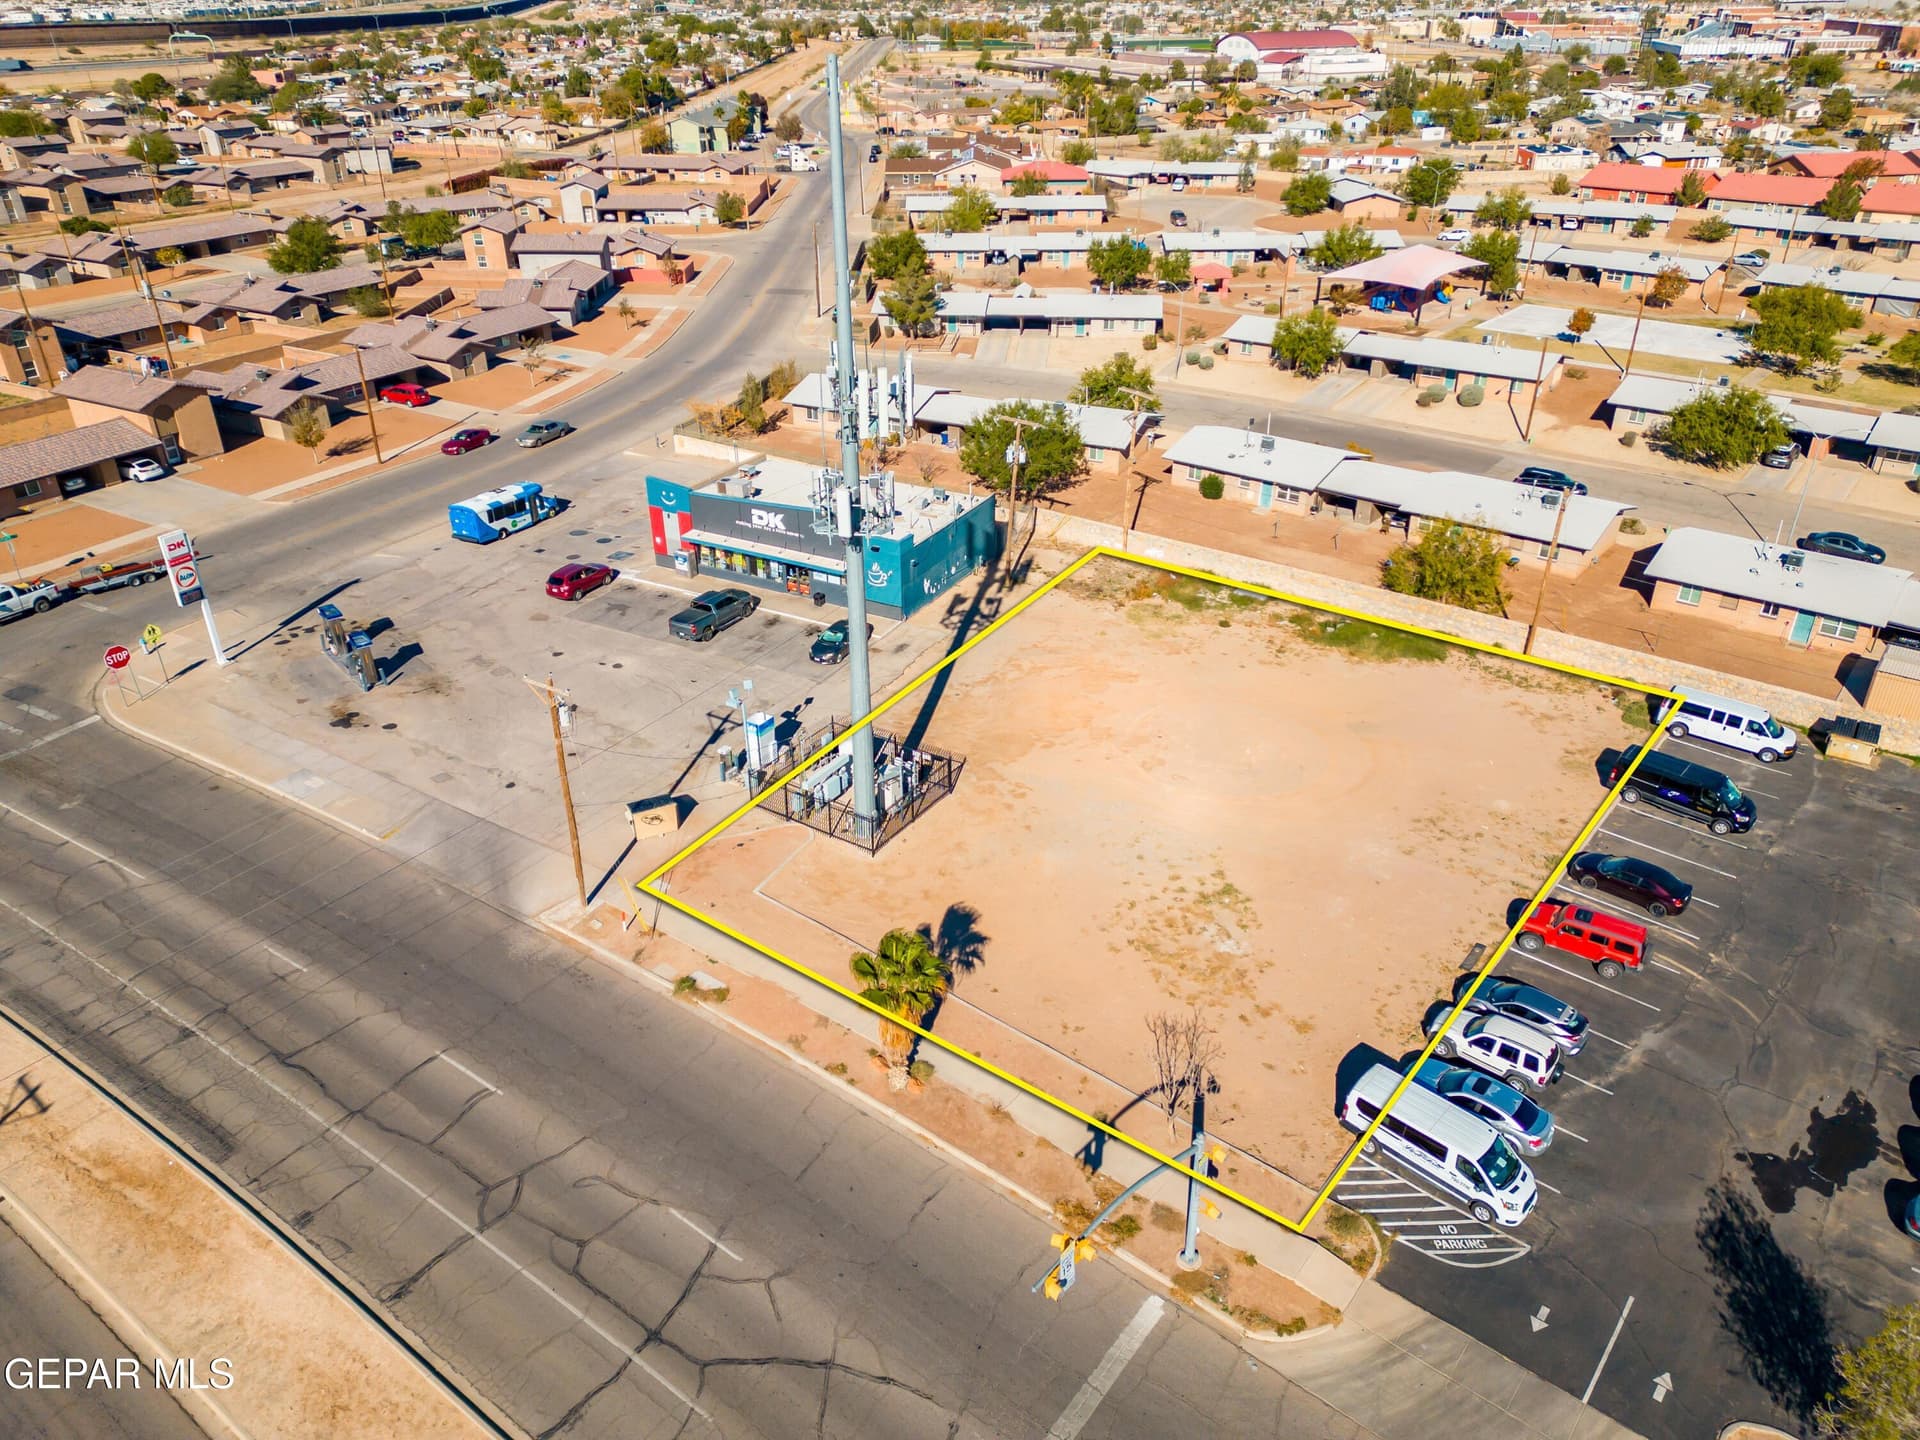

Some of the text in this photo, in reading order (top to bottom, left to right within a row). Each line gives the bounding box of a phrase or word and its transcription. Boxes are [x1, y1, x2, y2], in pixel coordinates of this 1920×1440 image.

[751, 508, 785, 529] DK
[167, 539, 186, 552] DK
[106, 650, 128, 665] STOP
[1438, 1225, 1458, 1235] NO
[1434, 1239, 1487, 1250] PARKING
